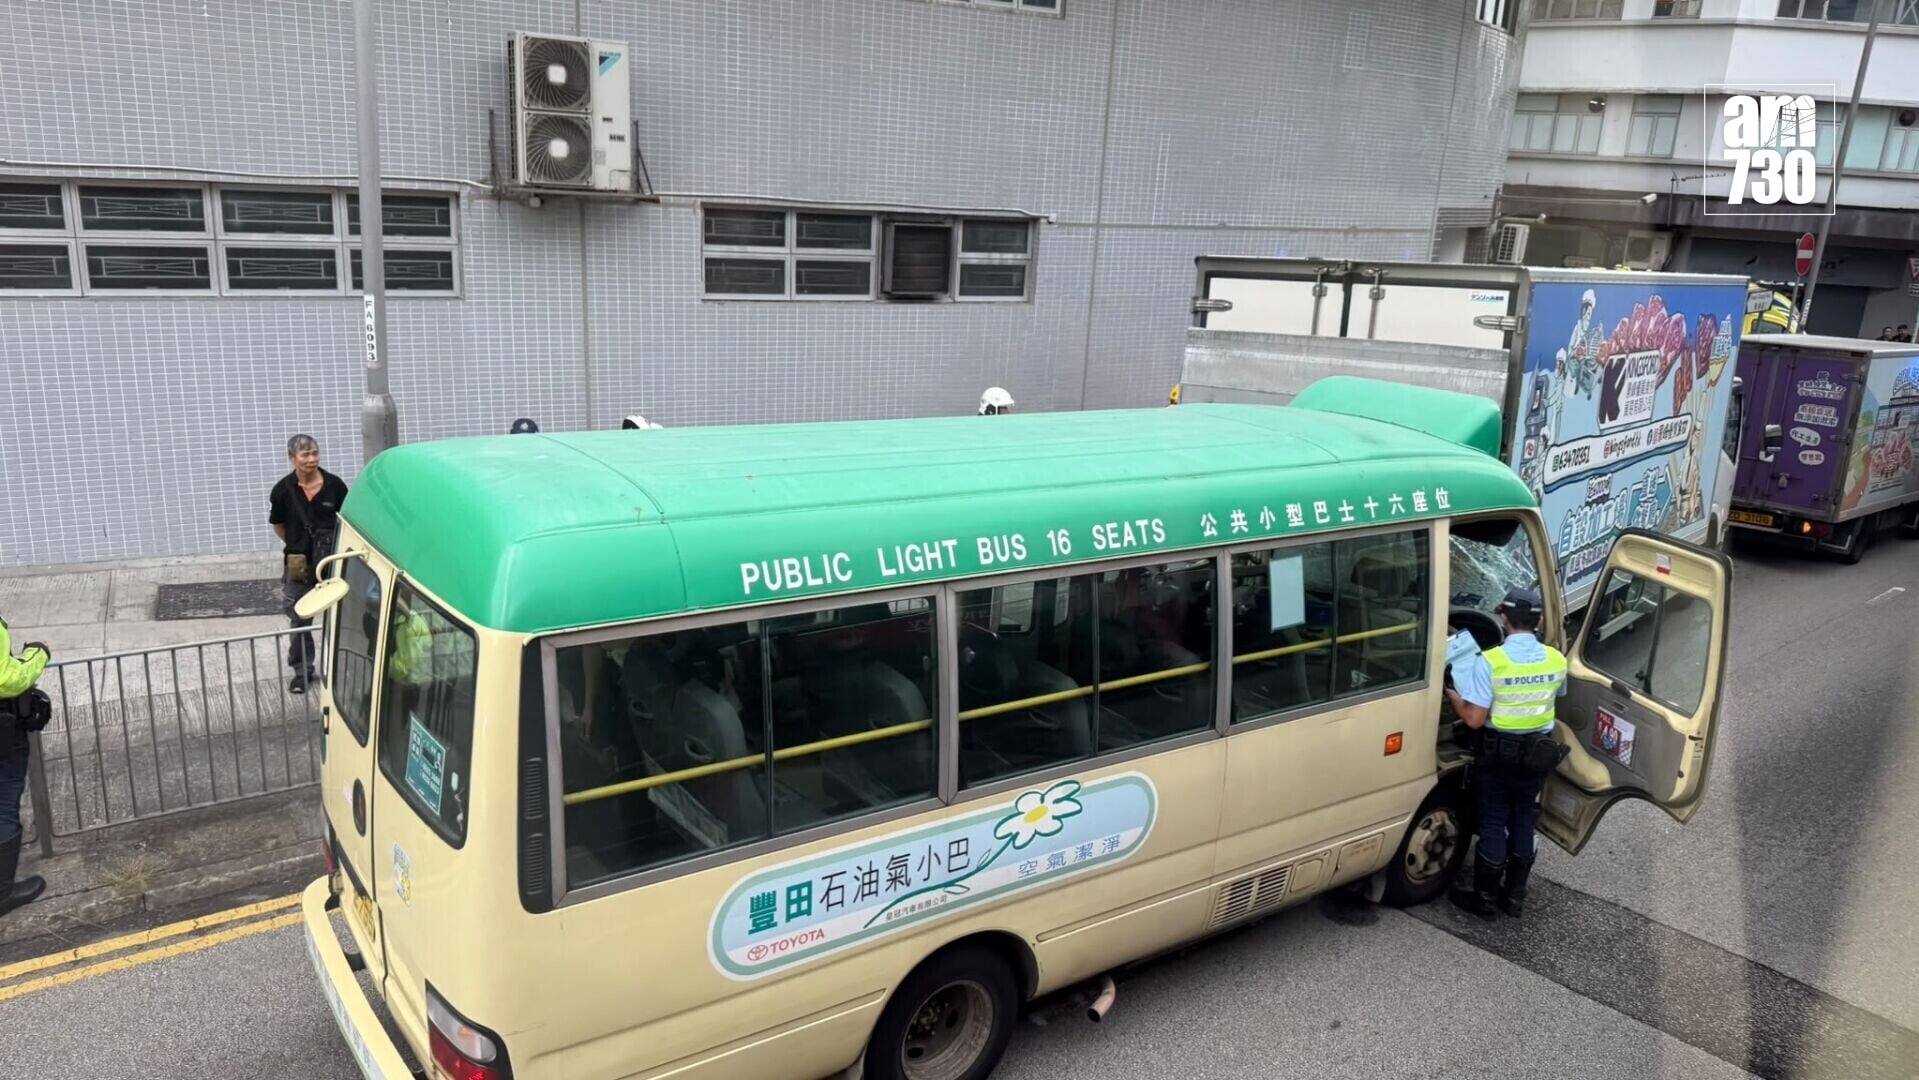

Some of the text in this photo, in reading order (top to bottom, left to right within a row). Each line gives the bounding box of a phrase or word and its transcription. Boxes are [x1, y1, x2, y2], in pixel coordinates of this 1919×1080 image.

[1200, 487, 1451, 537] 公共小型巴士十六座位
[740, 518, 1166, 595] PUBLIC LIGHT BUS 16 SEATS
[1515, 675, 1544, 684] POLICE
[1018, 834, 1121, 878] 空氣潔淨
[770, 928, 825, 955] TOYOTA
